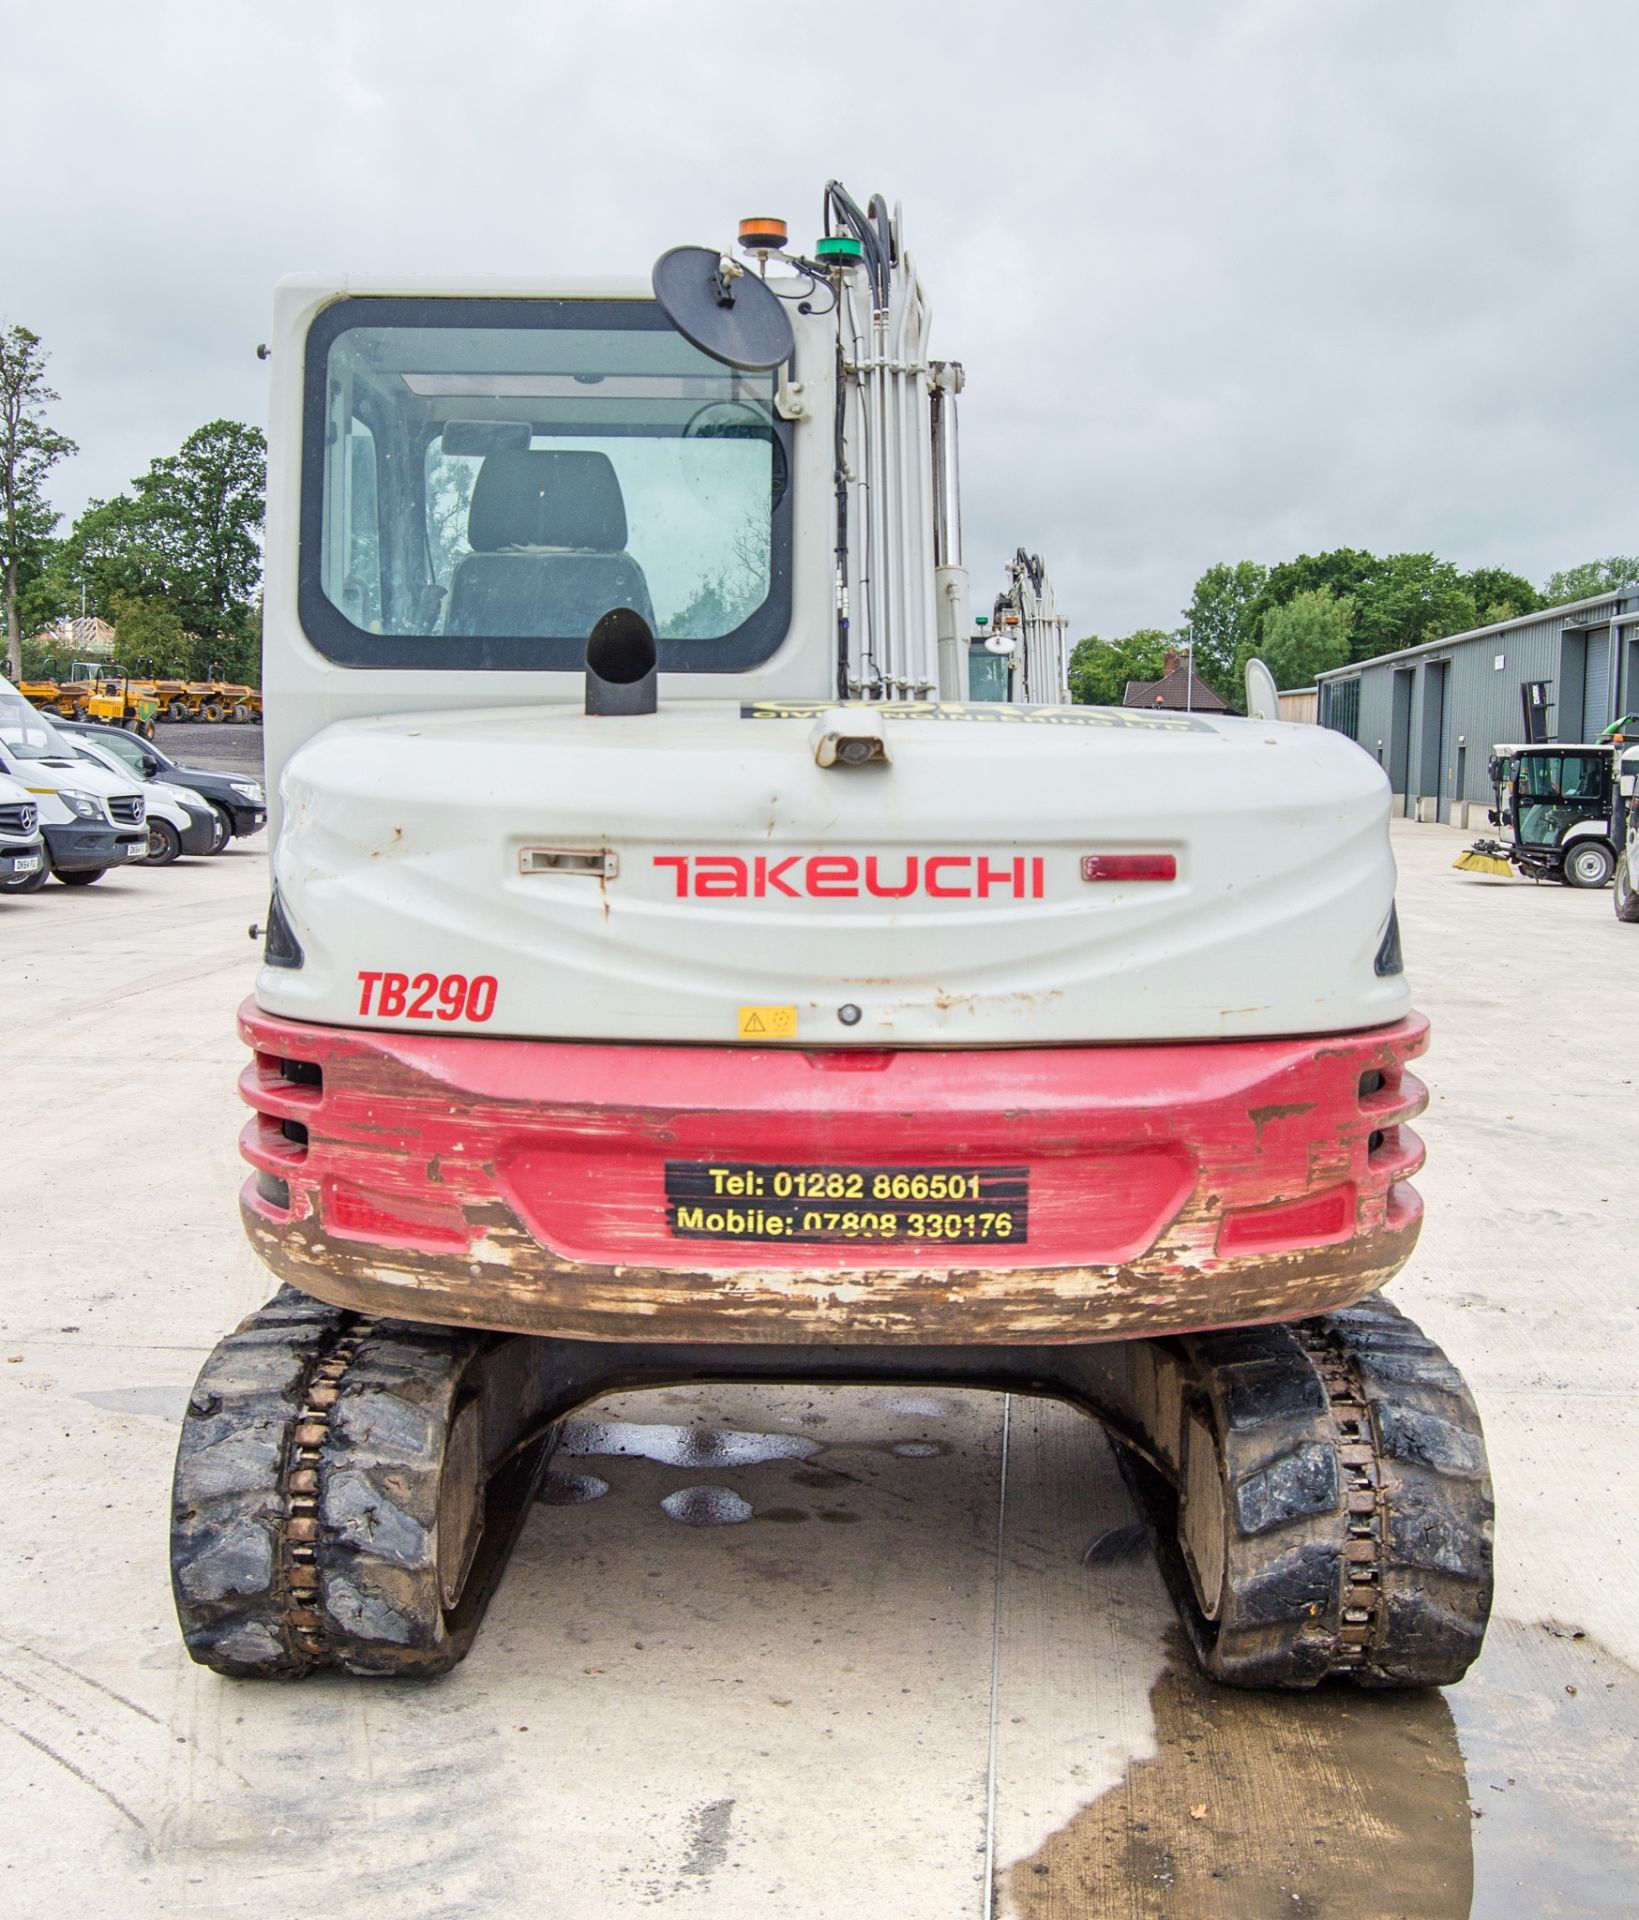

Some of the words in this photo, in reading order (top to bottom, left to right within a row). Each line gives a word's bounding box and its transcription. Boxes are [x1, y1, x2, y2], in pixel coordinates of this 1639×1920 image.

[752, 711, 824, 719] CIVI
[883, 712, 1113, 727] NGINEERING
[653, 855, 1044, 898] TAKEUCHI
[357, 971, 498, 1023] TB290
[708, 1169, 764, 1196] Tel:
[773, 1173, 864, 1198] 01282
[872, 1173, 981, 1200] 866501
[907, 1213, 1013, 1238] 330176
